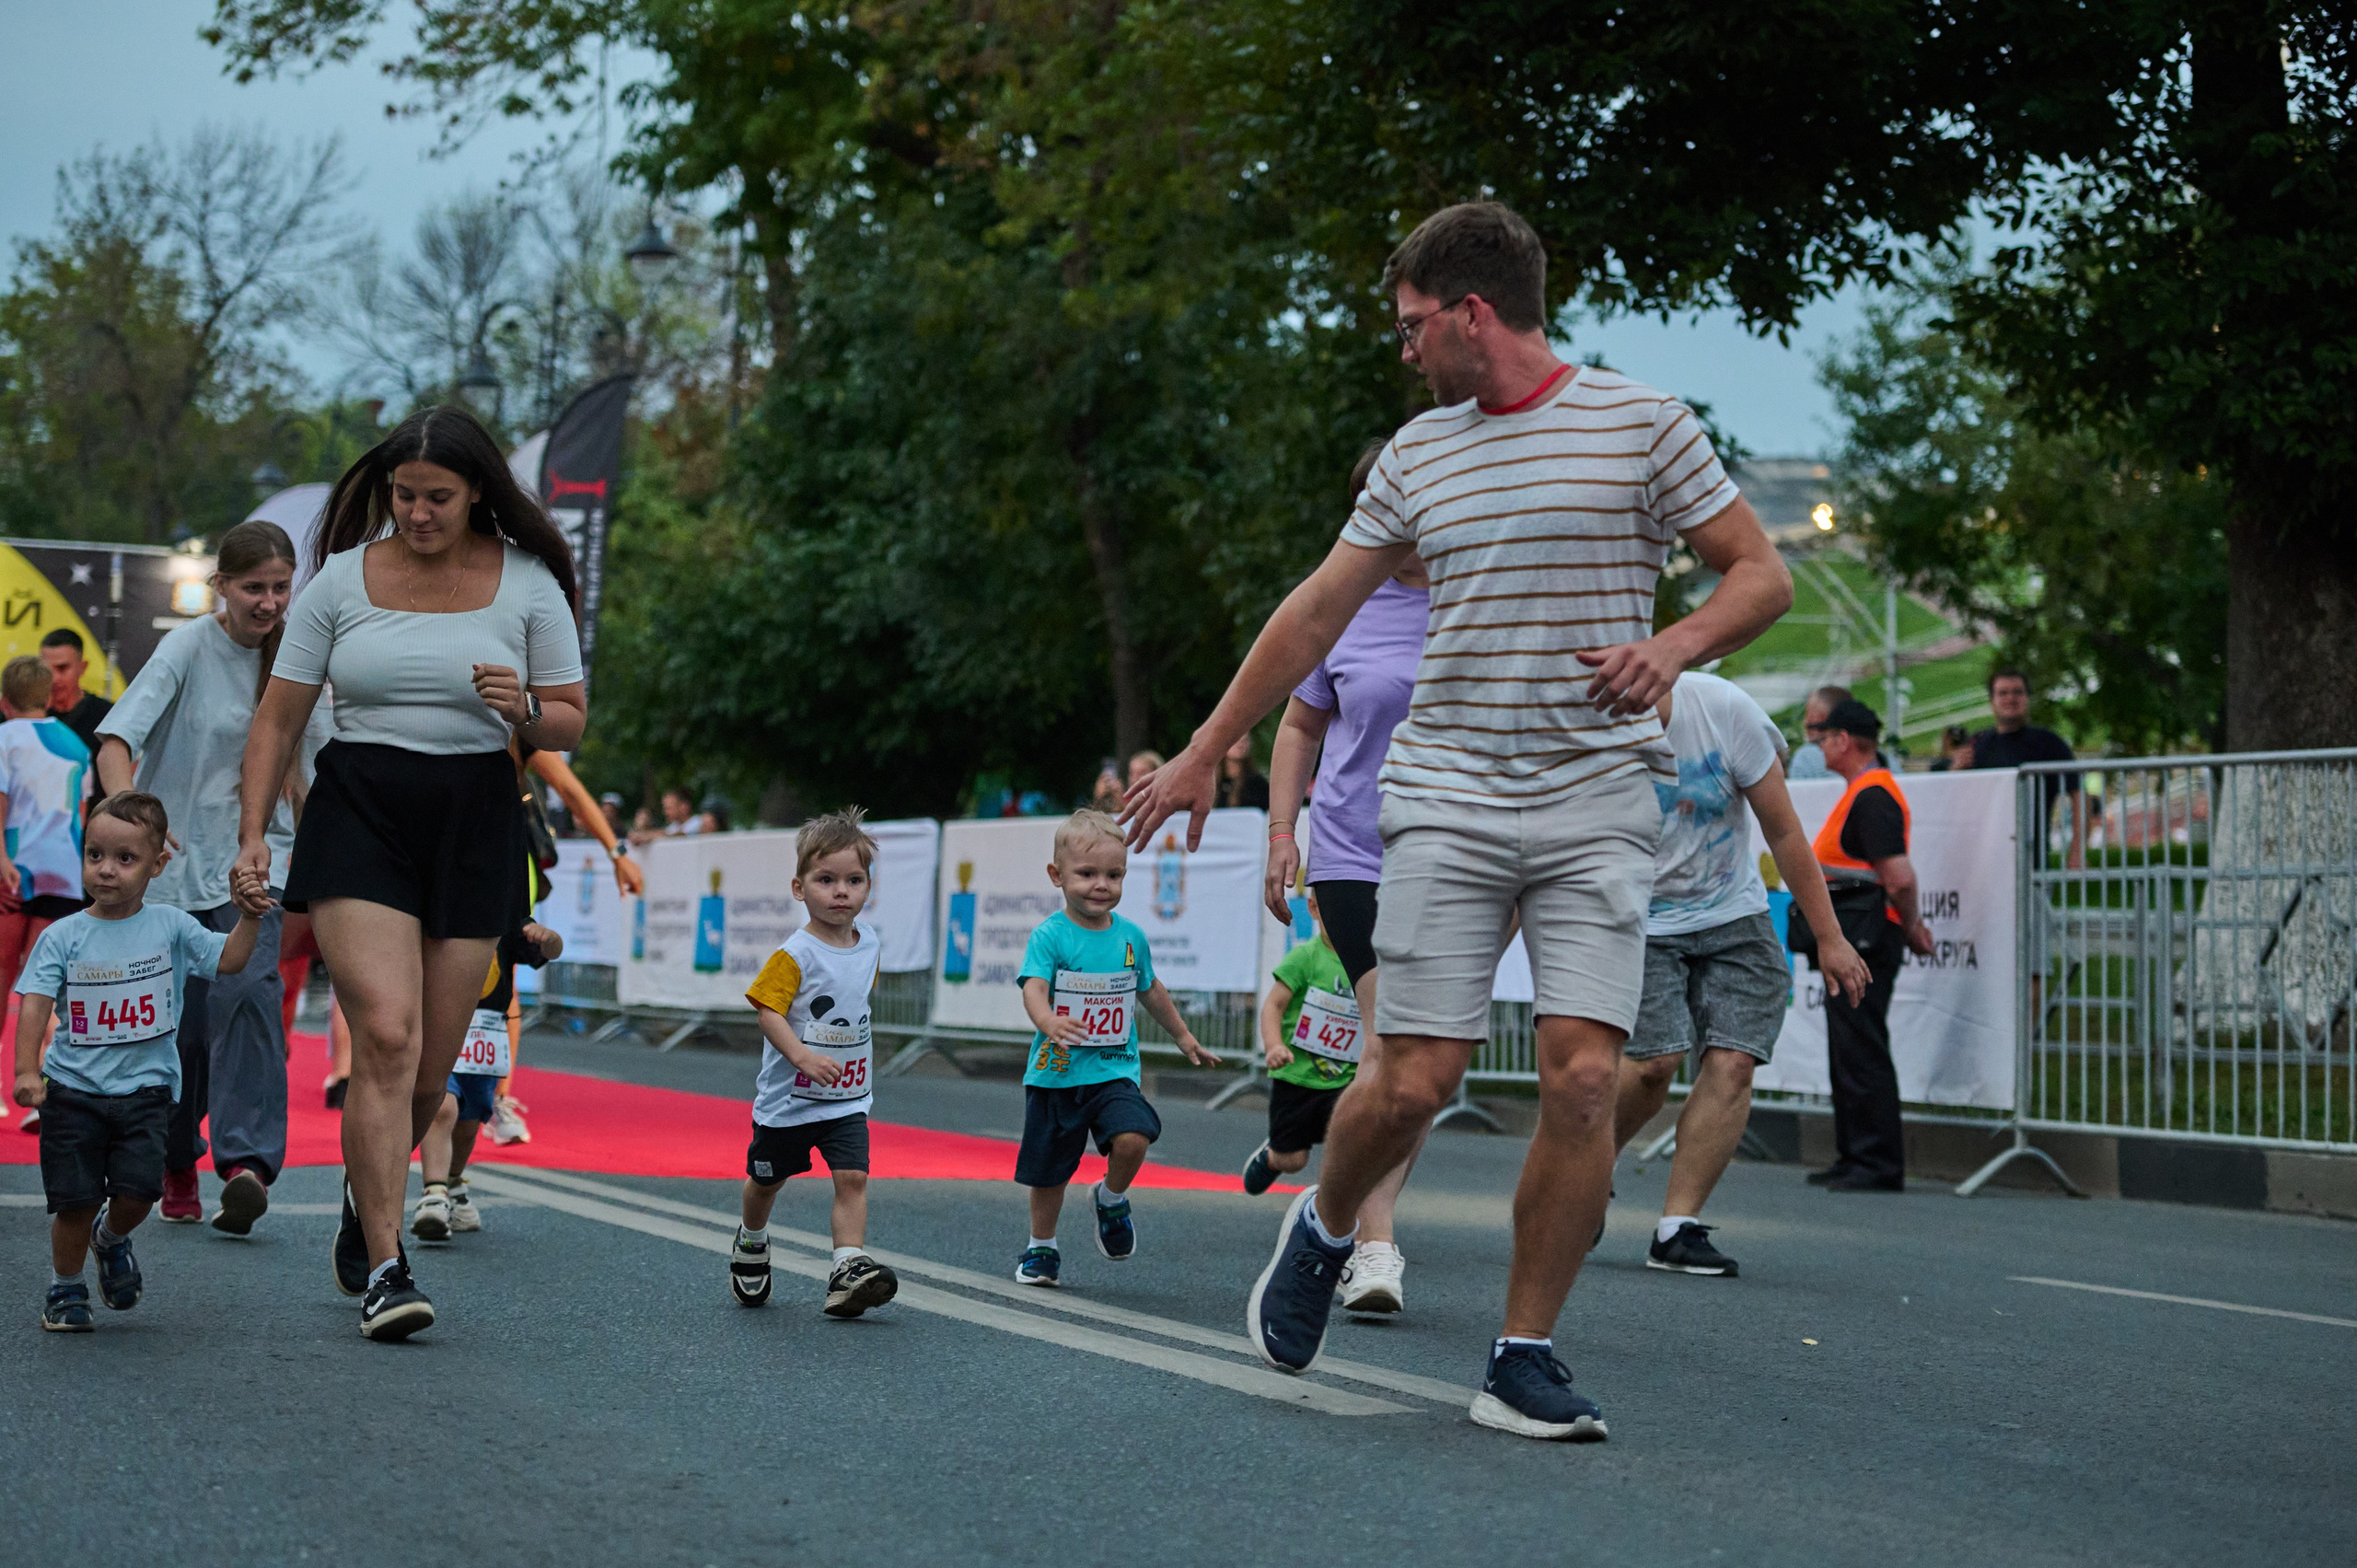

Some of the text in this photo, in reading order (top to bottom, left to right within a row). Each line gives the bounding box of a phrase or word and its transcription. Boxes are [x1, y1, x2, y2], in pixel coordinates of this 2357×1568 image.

[129, 955, 162, 970] НОЧНОЙ
[77, 970, 123, 981] САМАРЫ
[130, 965, 156, 977] ЗАБЕГ
[1066, 981, 1106, 991] САМАРЫ
[1084, 996, 1124, 1005] МАКСИМ
[98, 993, 156, 1031] 445
[1081, 1007, 1124, 1036] 420
[816, 1033, 855, 1043] САМАРЫ
[1318, 1023, 1357, 1051] 427
[459, 1040, 495, 1066] 409
